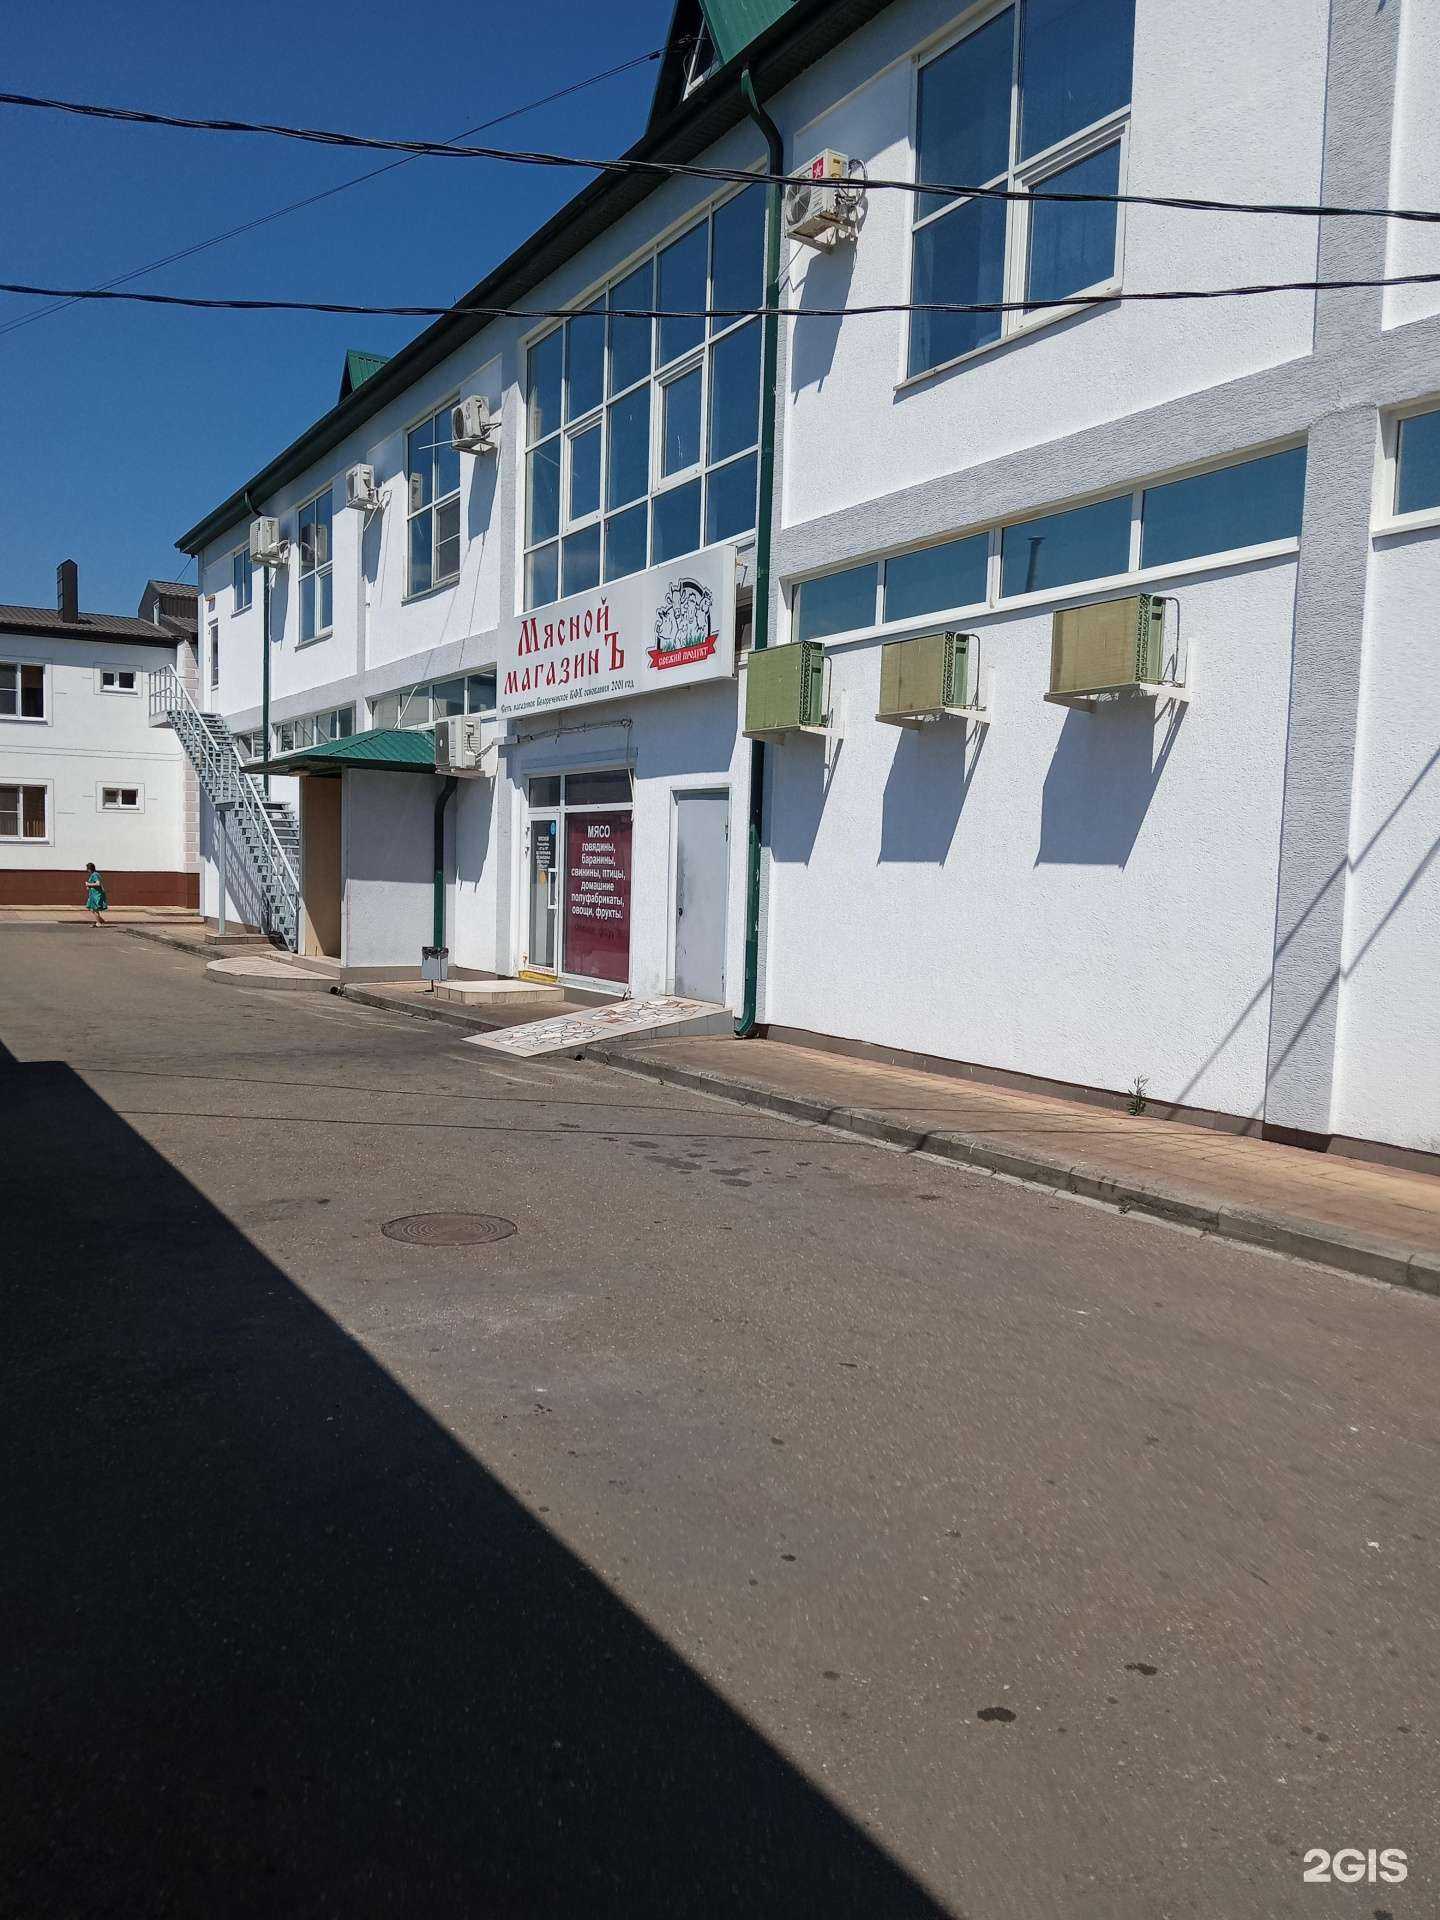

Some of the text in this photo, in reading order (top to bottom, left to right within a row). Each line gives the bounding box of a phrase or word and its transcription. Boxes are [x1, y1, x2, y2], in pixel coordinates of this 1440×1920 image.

[518, 595, 609, 657] Мясной
[587, 825, 611, 838] МЯСО
[582, 842, 616, 853] говядины,
[581, 853, 616, 867] баранины,
[581, 882, 615, 892] домашние
[571, 892, 625, 907] полуфабрикаты,
